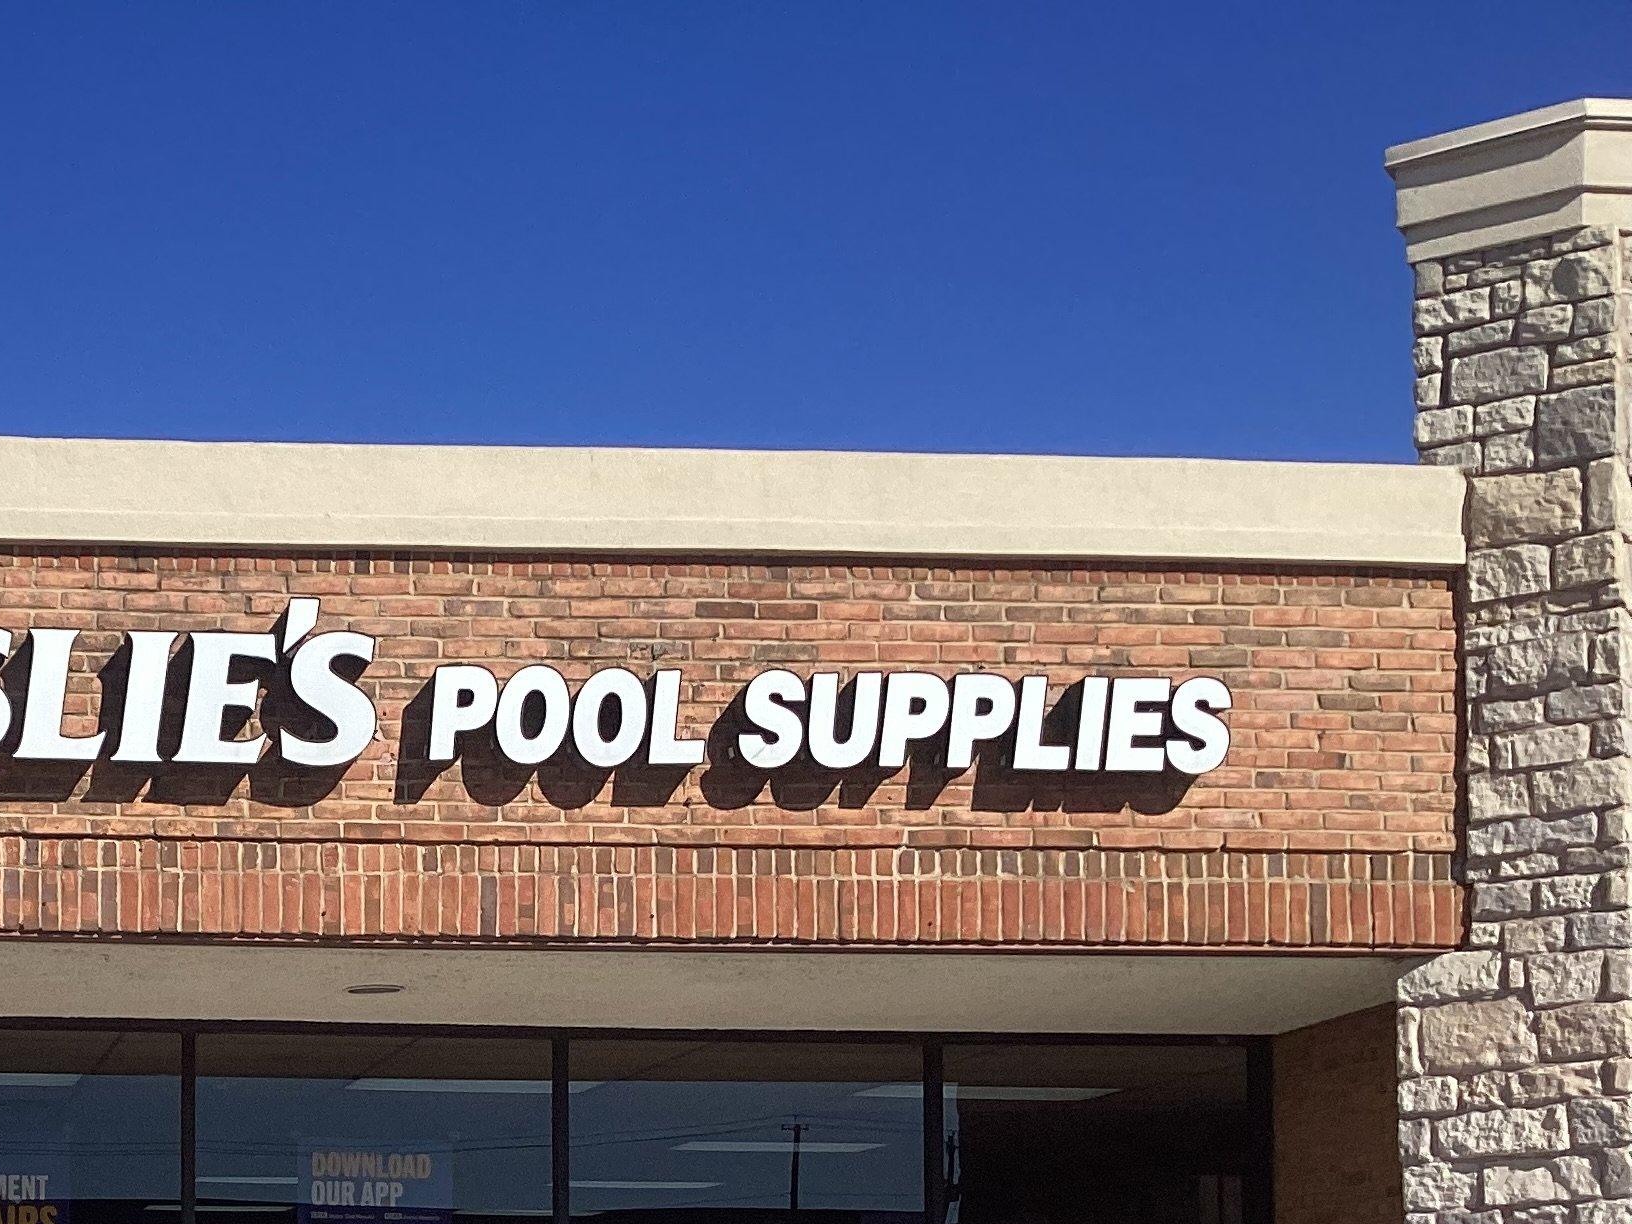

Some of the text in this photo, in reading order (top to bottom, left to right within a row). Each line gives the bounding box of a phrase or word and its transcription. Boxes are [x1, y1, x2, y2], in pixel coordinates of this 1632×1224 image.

[428, 664, 706, 768] POOL
[739, 669, 1234, 775] SUPPLIES
[312, 1151, 432, 1179] DOWNLOAD
[311, 1180, 403, 1207] OUR APP
